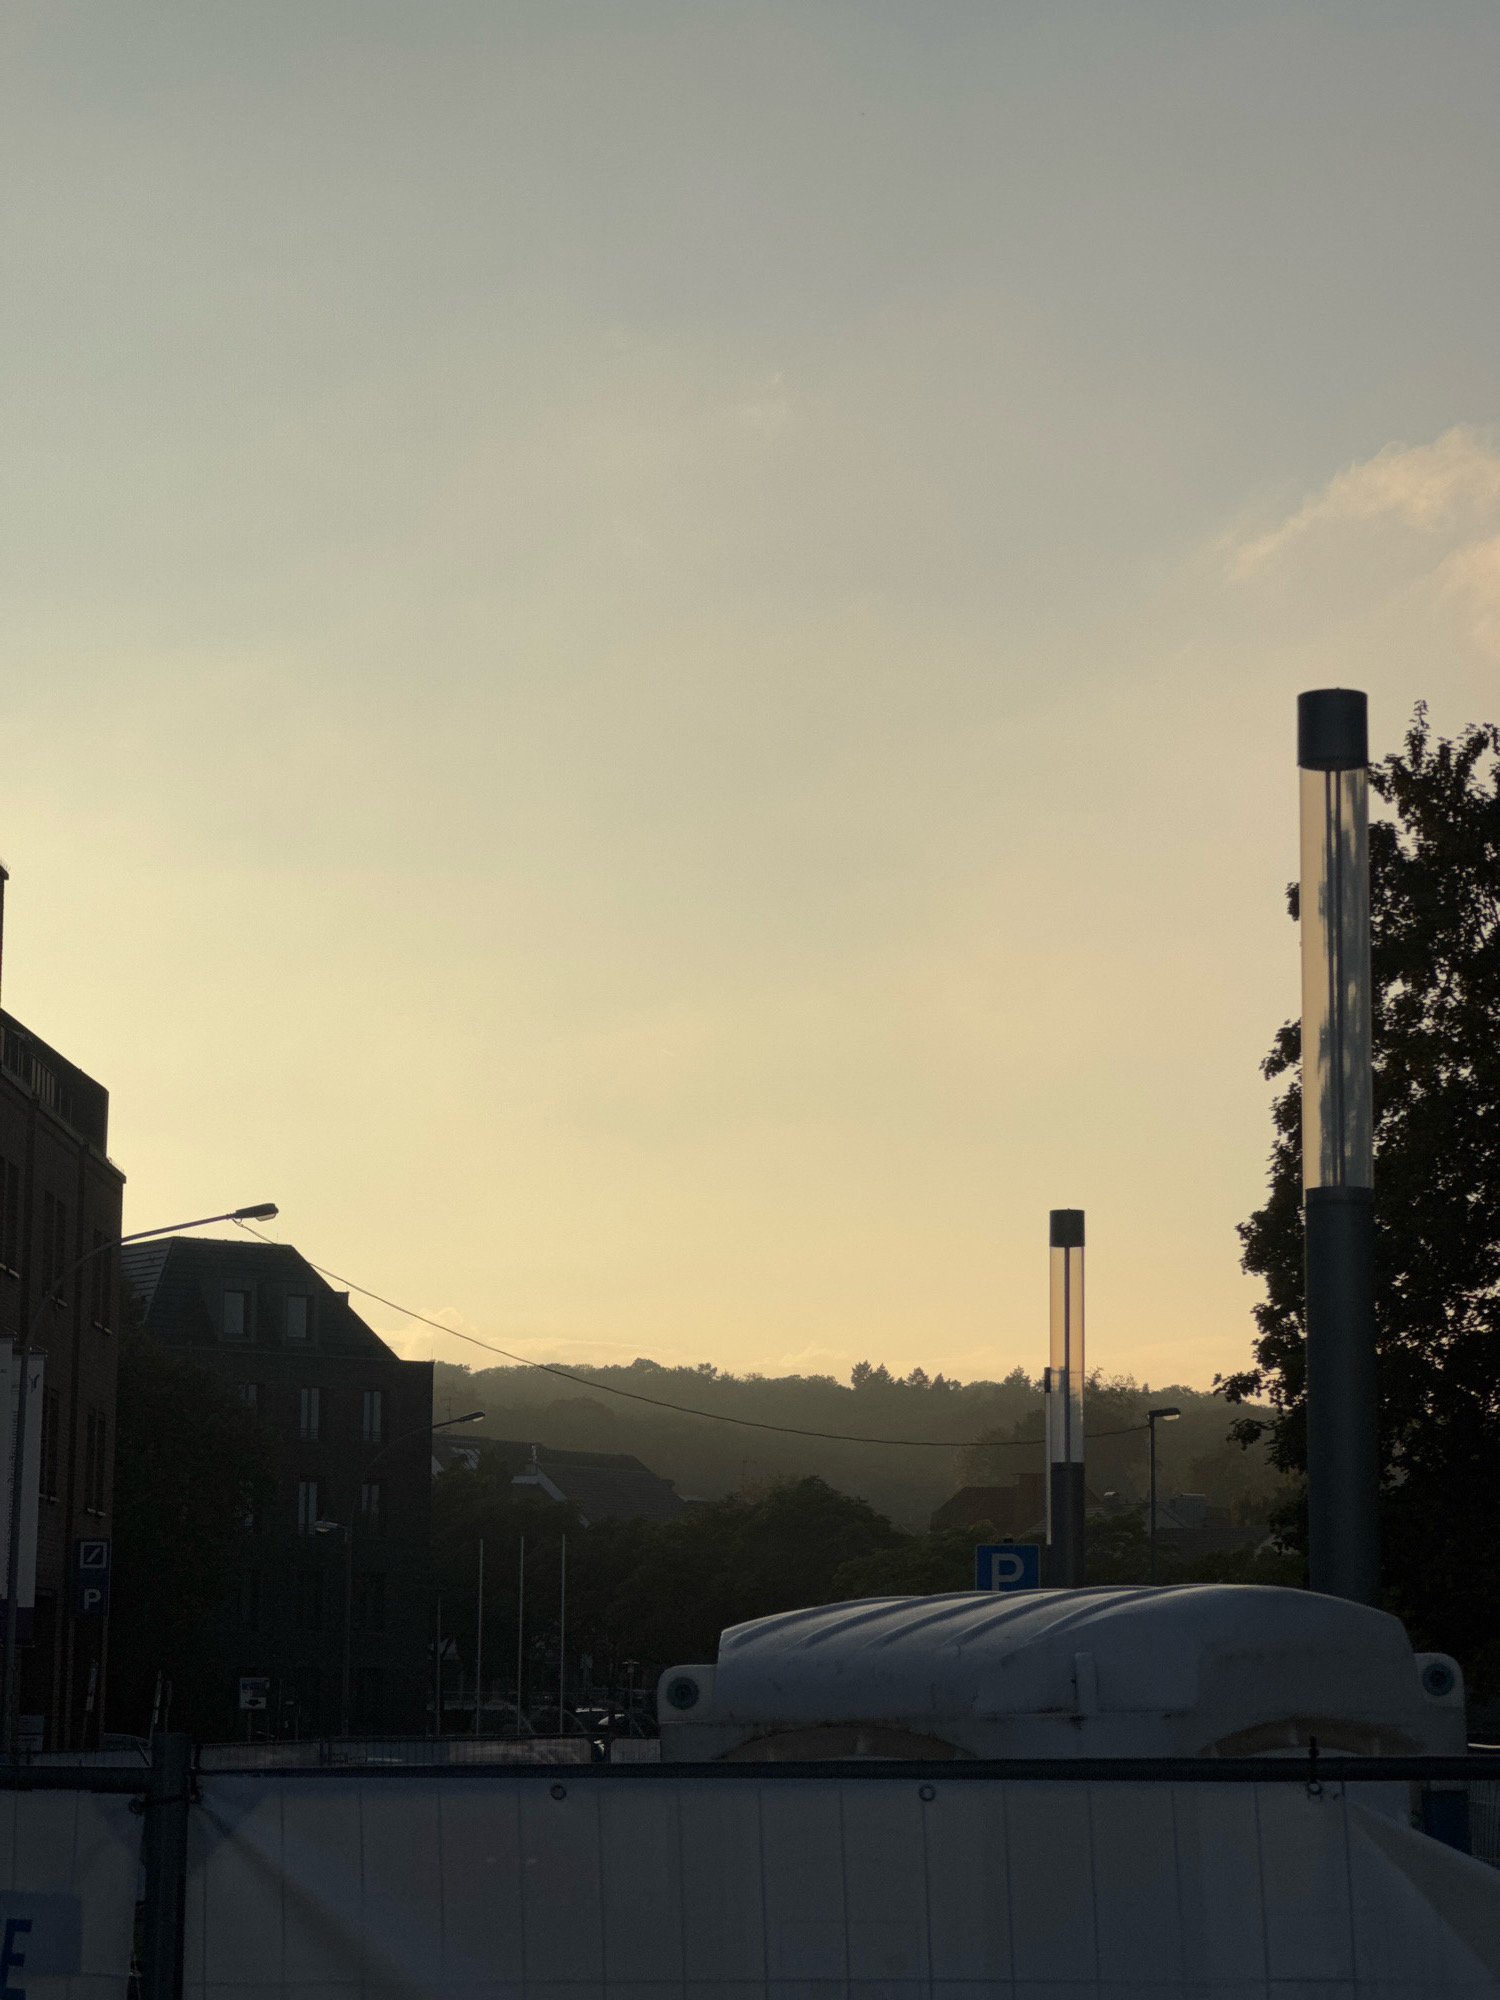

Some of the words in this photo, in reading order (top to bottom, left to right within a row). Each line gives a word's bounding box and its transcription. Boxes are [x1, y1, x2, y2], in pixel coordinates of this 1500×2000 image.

[992, 1553, 1024, 1591] P
[83, 1588, 101, 1610] P
[0, 1919, 33, 2000] E
